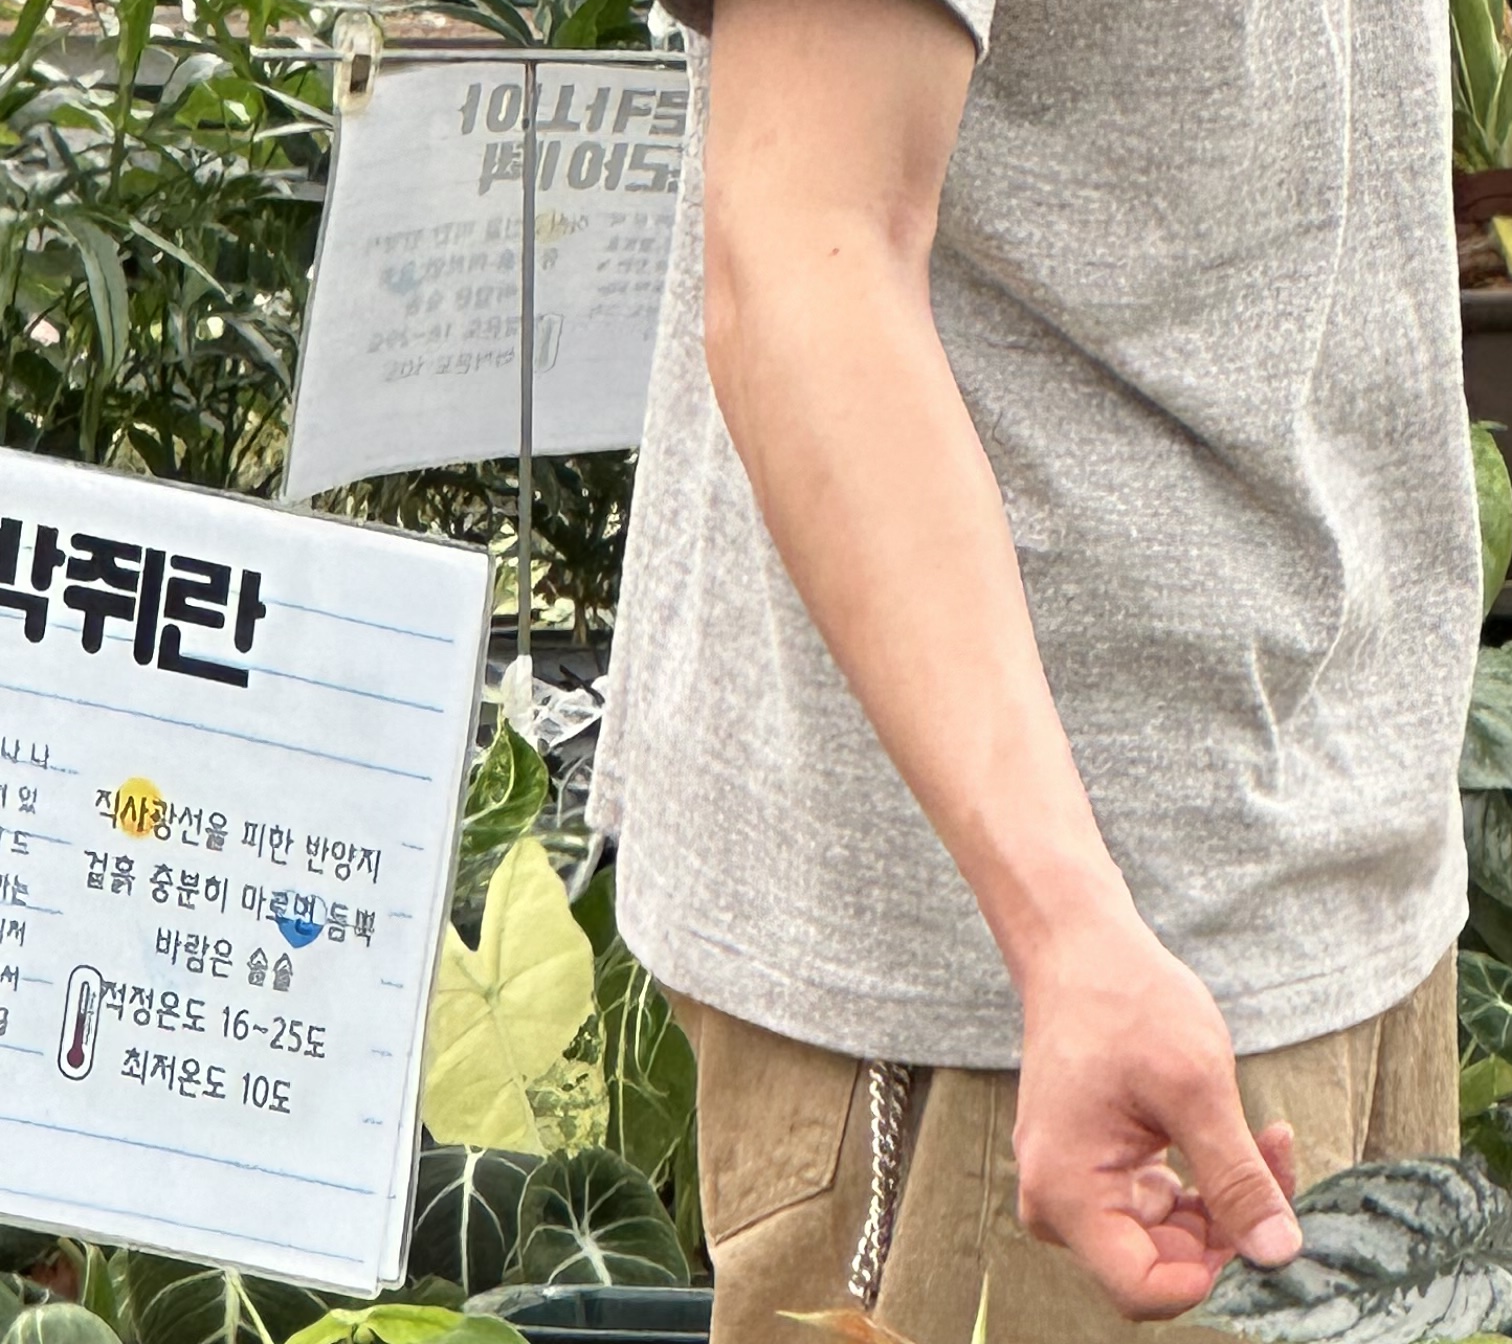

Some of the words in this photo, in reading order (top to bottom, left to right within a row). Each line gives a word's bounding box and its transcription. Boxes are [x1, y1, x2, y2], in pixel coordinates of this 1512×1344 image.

[94, 788, 229, 853] 직사광선을
[241, 820, 295, 866] 피한
[305, 834, 382, 885] 반양지
[149, 862, 229, 915] 충분히
[155, 926, 234, 979] 바람은
[99, 978, 207, 1034] 적정온도
[222, 1004, 327, 1059] 16~25도
[120, 1046, 227, 1100] 최저온도
[242, 1071, 292, 1114] 10도
